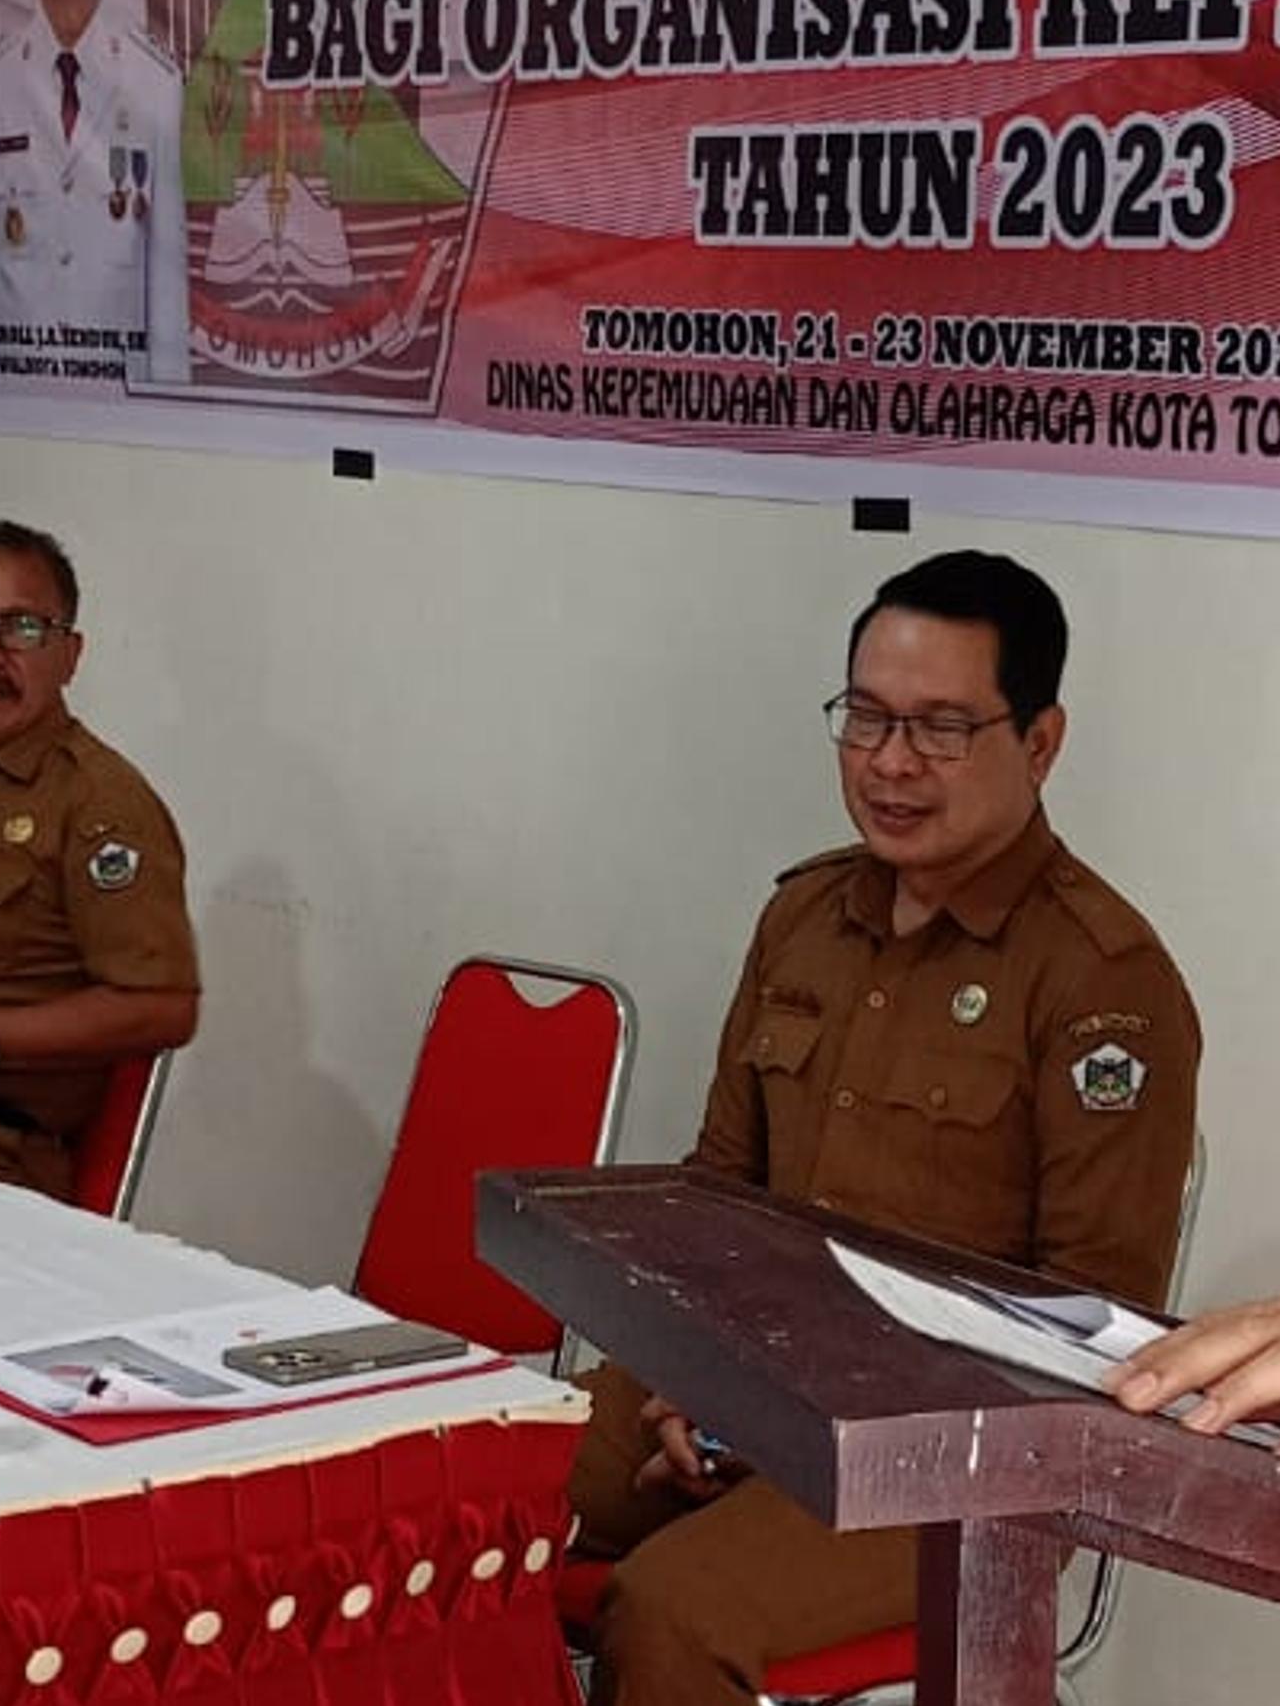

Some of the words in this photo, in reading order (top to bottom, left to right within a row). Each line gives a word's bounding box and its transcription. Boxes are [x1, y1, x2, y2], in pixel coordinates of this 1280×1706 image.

[692, 129, 977, 240] TAHUN
[996, 122, 1228, 240] 2023
[584, 309, 788, 367] TOMOHON,
[795, 314, 836, 361] 21
[875, 317, 922, 363] 23
[933, 319, 1203, 376] NOVEMBER
[486, 359, 574, 414] DINAS
[583, 365, 797, 428] KEPEMUDAAN
[808, 377, 878, 433] DAN
[890, 380, 1095, 445] OLAHRAGA
[1108, 391, 1218, 453] KOTA
